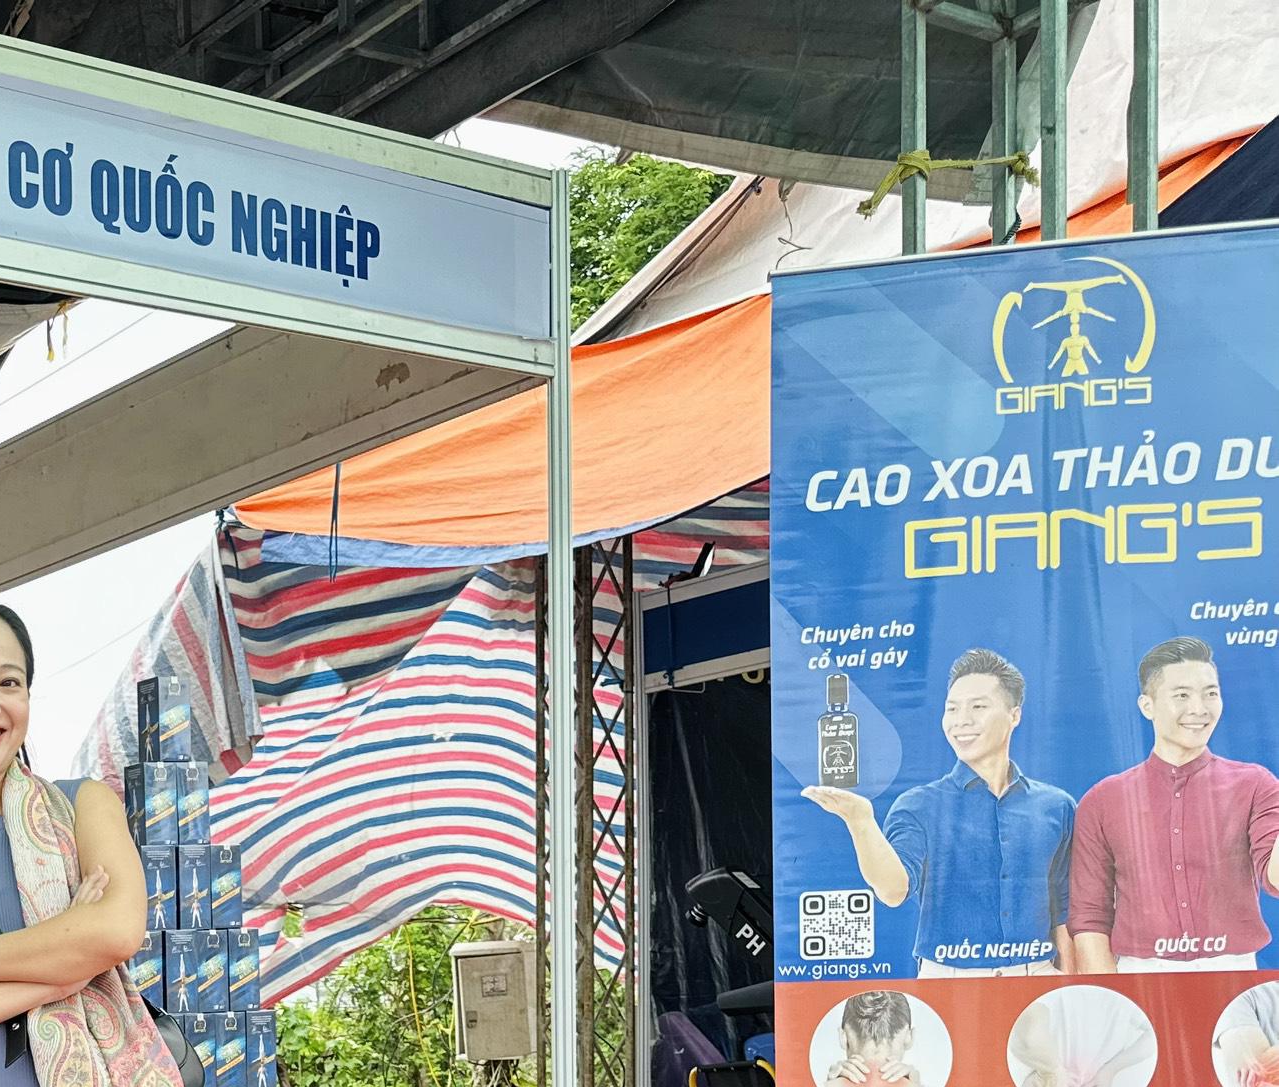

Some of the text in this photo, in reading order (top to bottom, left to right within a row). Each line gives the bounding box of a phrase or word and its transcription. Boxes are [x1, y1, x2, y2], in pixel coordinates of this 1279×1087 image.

[8, 140, 74, 216] CƠ
[90, 154, 214, 247] QUỐC
[231, 190, 381, 288] NGHIỆP
[996, 376, 1152, 415] GIANG'S
[805, 464, 911, 513] CAO
[922, 453, 1034, 502] XOA
[1052, 430, 1201, 493] THẢO
[904, 497, 1263, 579] GIANG'S
[1190, 598, 1268, 622] Chuyên
[801, 620, 915, 645] Chuyên cho
[1225, 626, 1278, 648] vùng
[808, 646, 908, 670] cổ vai gáy
[934, 937, 1053, 964] QUỐC NGHIỆP
[1154, 932, 1228, 956] QUỐC CƠ
